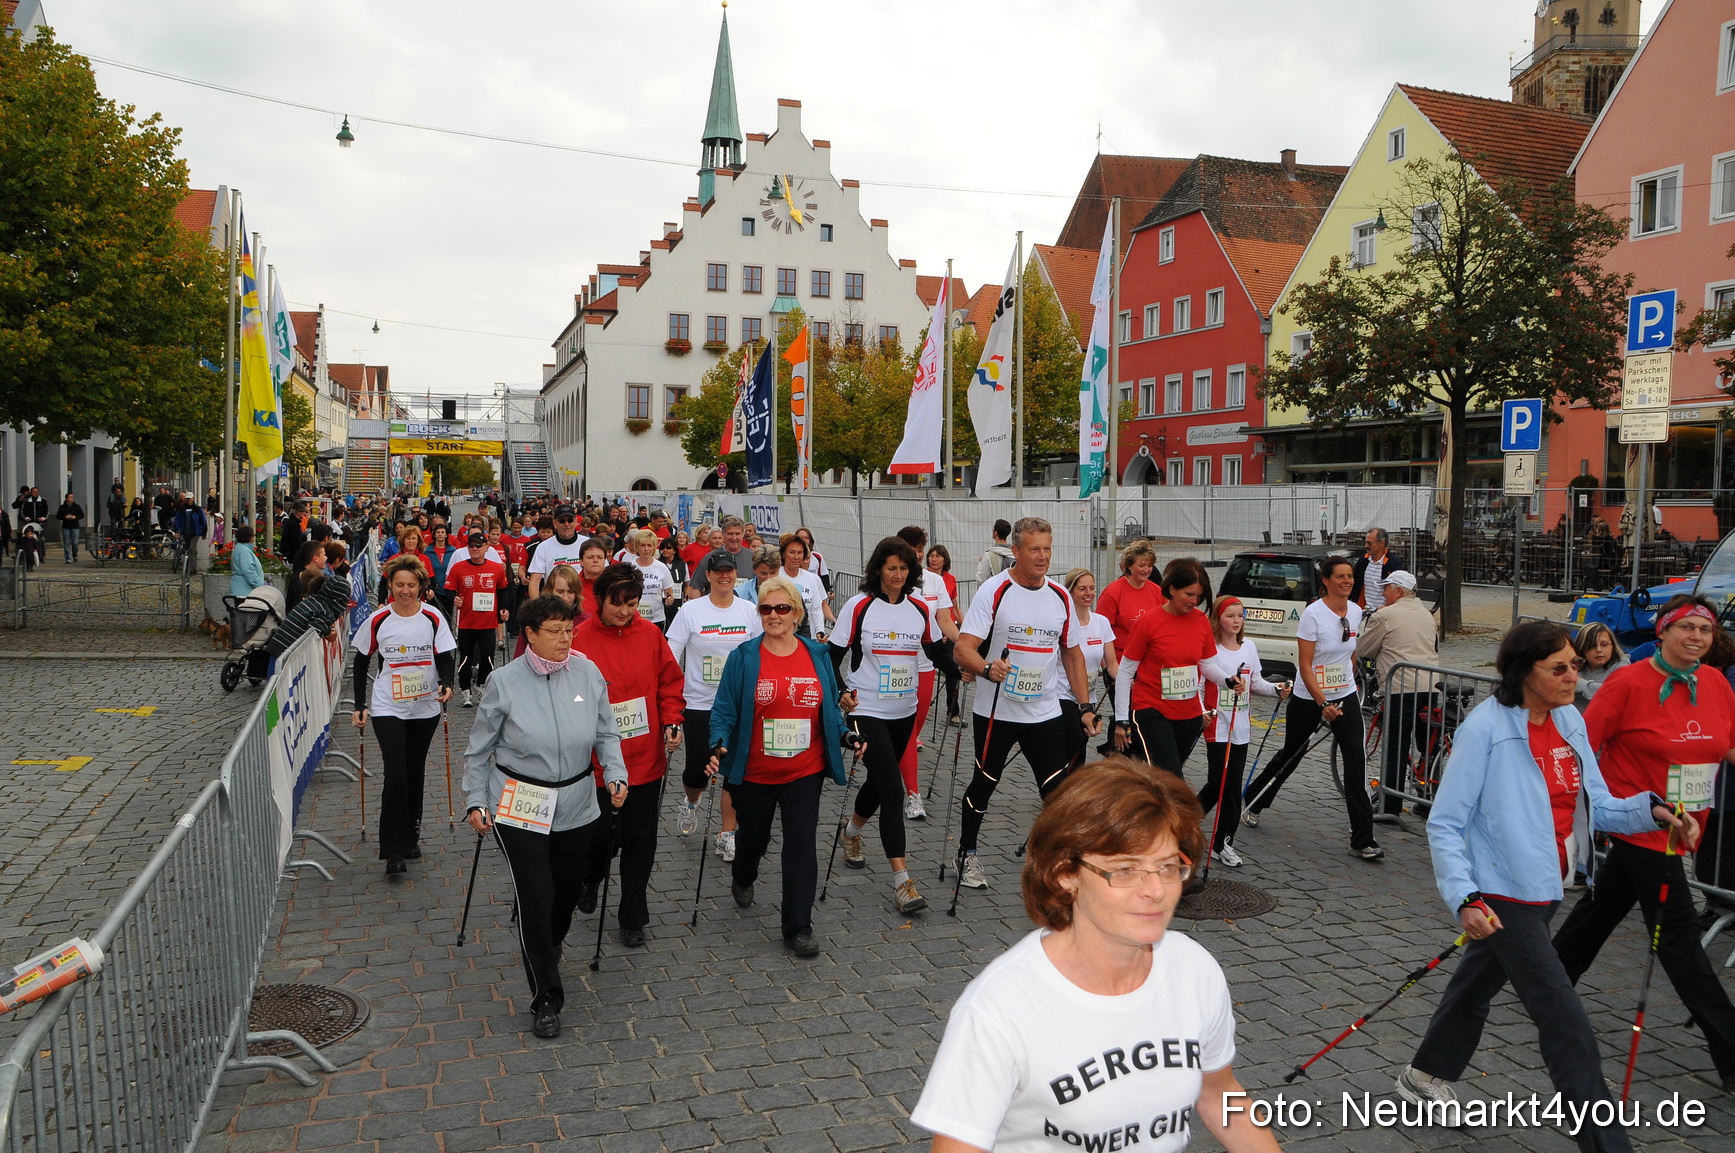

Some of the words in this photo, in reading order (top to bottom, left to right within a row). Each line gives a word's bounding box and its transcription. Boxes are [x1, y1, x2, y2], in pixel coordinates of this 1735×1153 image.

[1637, 300, 1664, 344] P
[1628, 366, 1668, 375] Parkschein
[1631, 376, 1664, 384] werktags
[253, 408, 280, 430] KA
[1510, 406, 1533, 444] P
[408, 423, 450, 435] BOCK
[1189, 429, 1212, 442] Gasthaus
[427, 441, 465, 452] START
[281, 465, 287, 474] P
[751, 505, 781, 533] BOCK
[644, 573, 659, 581] GER
[1245, 608, 1255, 618] NM
[1258, 609, 1268, 619] PJ
[1268, 610, 1283, 621] 300
[891, 667, 908, 675] Monika
[1019, 670, 1041, 679] Gerhard
[891, 677, 913, 688] 8027
[1173, 678, 1196, 689] 8001
[1326, 673, 1347, 684] 8002
[404, 682, 429, 693] 8036
[1017, 680, 1043, 691] 8026
[613, 704, 628, 714] Heidi
[616, 712, 643, 728] 8071
[777, 733, 807, 745] 8013
[517, 785, 550, 801] Christina
[1685, 781, 1712, 795] 8005
[514, 799, 549, 819] 8044
[1048, 1037, 1202, 1106] BERGER
[1043, 1117, 1141, 1153] POWER
[1148, 1104, 1193, 1140] GIR
